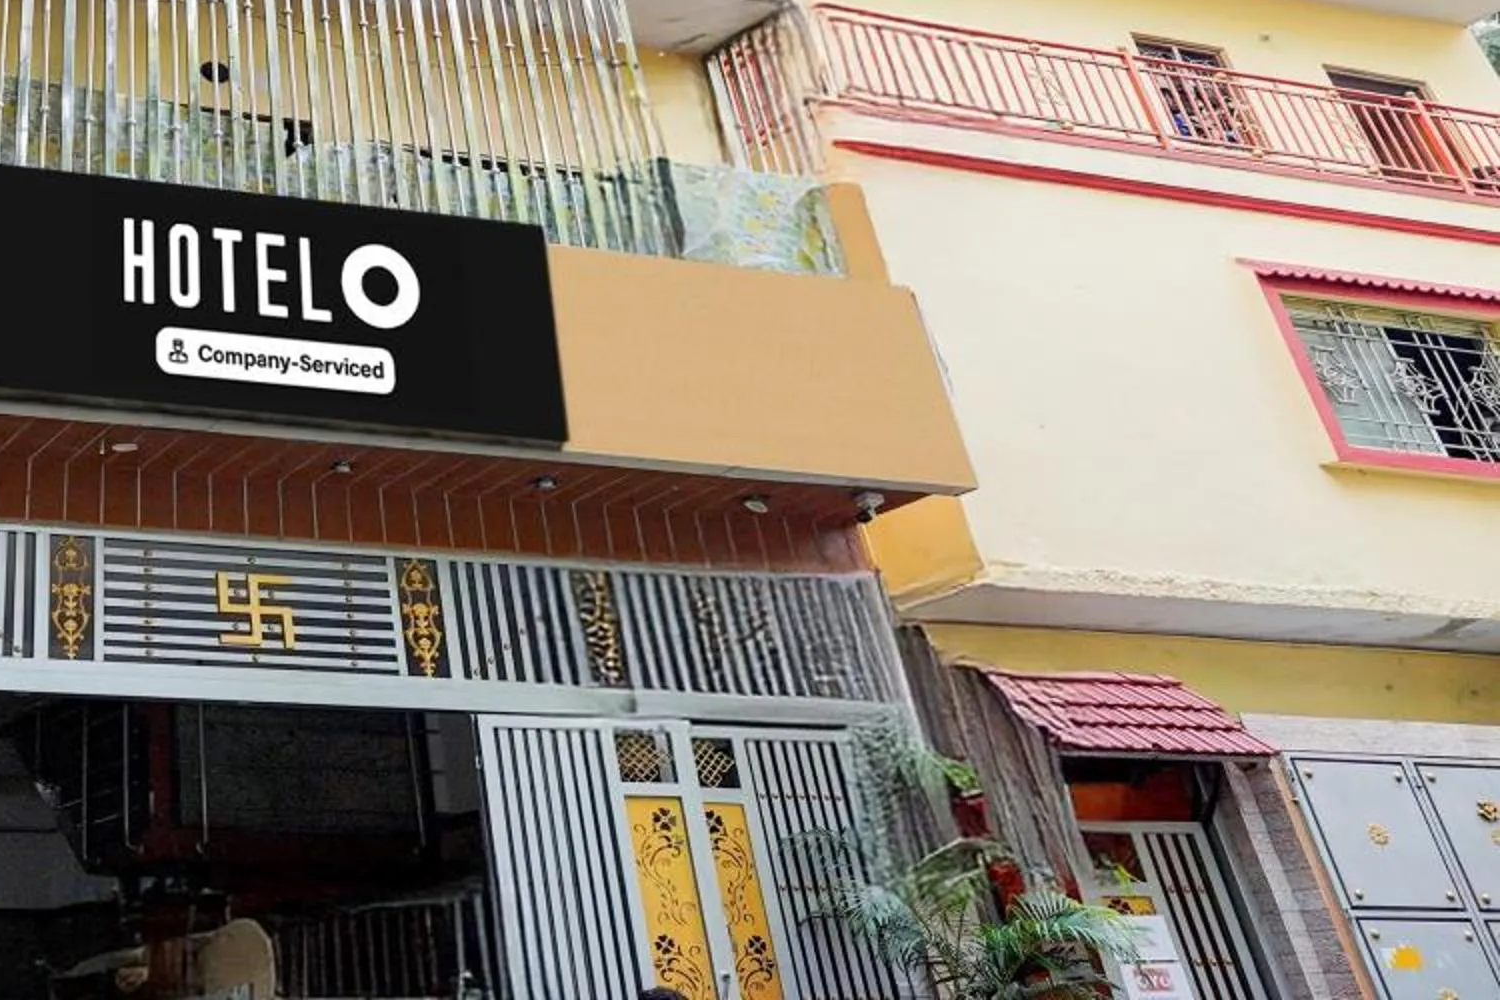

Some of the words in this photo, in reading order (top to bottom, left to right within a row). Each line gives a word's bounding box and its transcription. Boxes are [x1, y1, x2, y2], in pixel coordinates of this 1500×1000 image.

[123, 217, 333, 323] HOTEL
[341, 243, 421, 329] O
[197, 343, 385, 379] Company-Serviced
